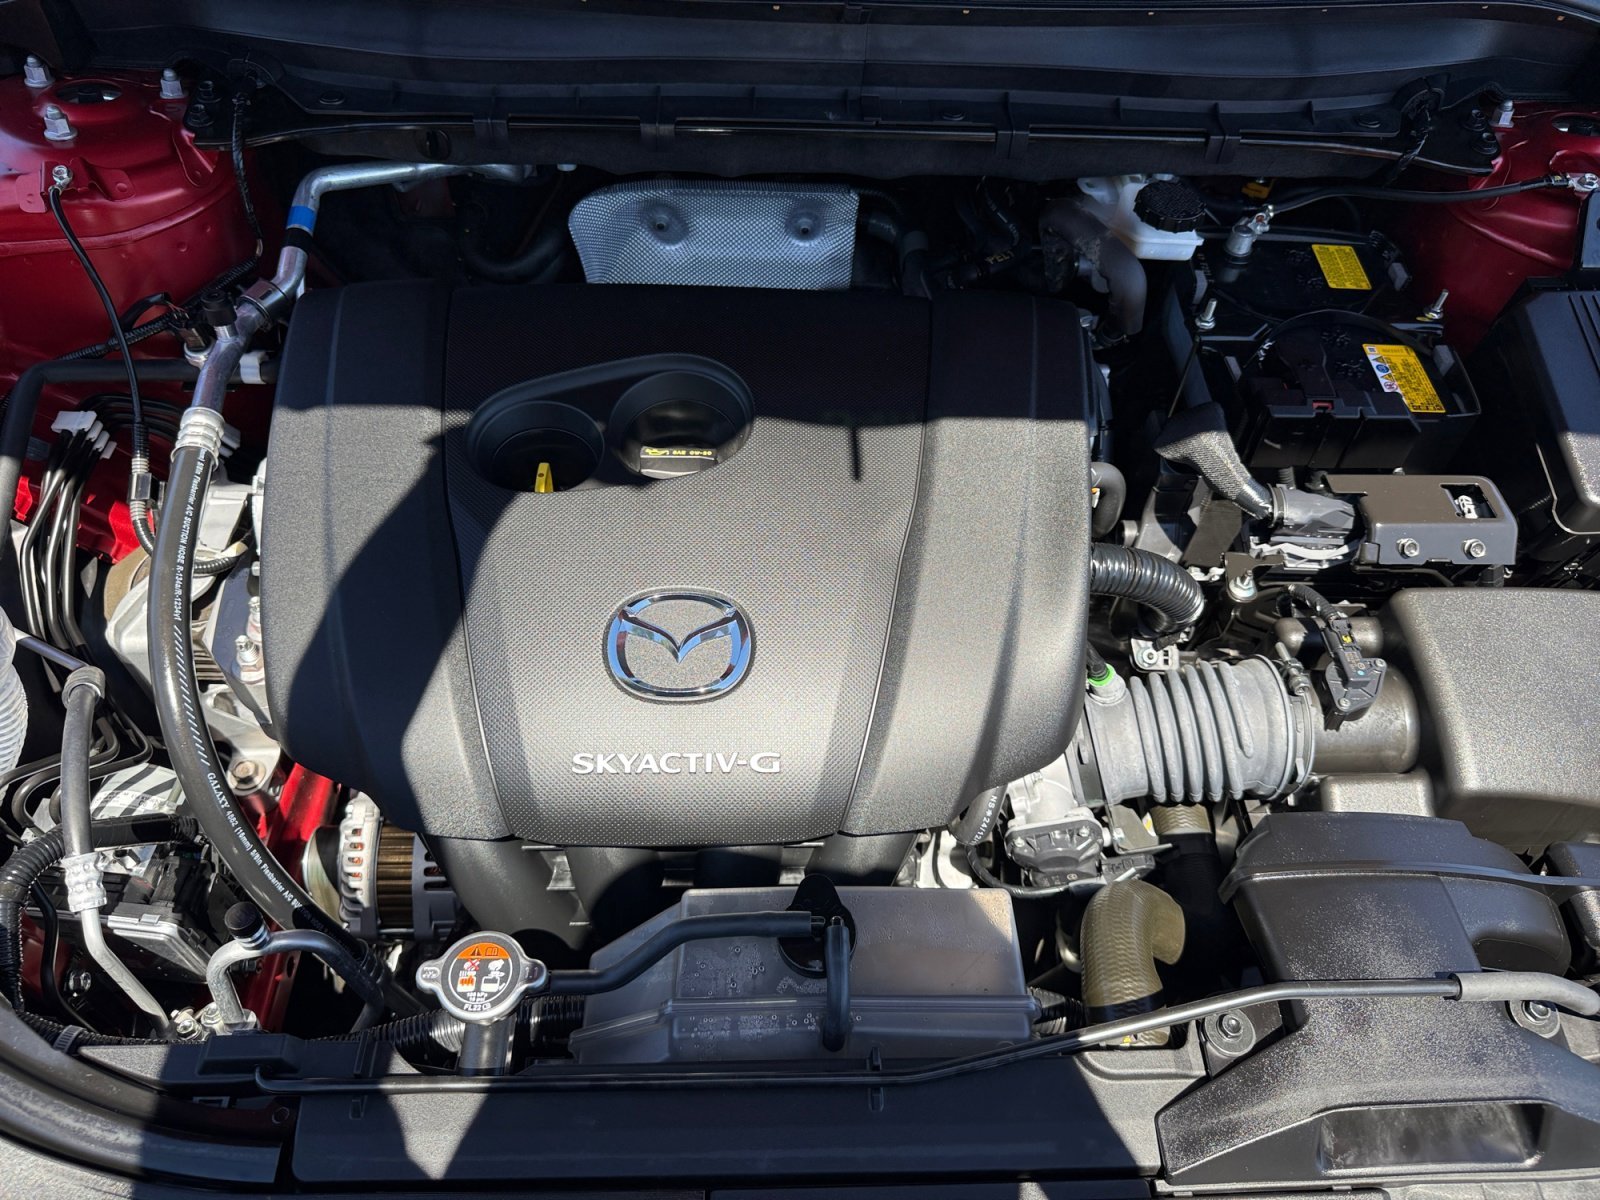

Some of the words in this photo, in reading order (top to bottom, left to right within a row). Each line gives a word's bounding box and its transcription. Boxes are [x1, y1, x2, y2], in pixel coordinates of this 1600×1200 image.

[188, 474, 201, 505] Flexbarrier
[185, 503, 194, 517] A/C
[180, 516, 192, 545] SUCTION
[176, 544, 187, 565] HOSE
[571, 752, 781, 774] SKYACTIV-G
[207, 772, 231, 809] GALAXY
[260, 863, 285, 893] Flexbarrier
[282, 890, 294, 902] A/C
[463, 1003, 482, 1011] FL22
